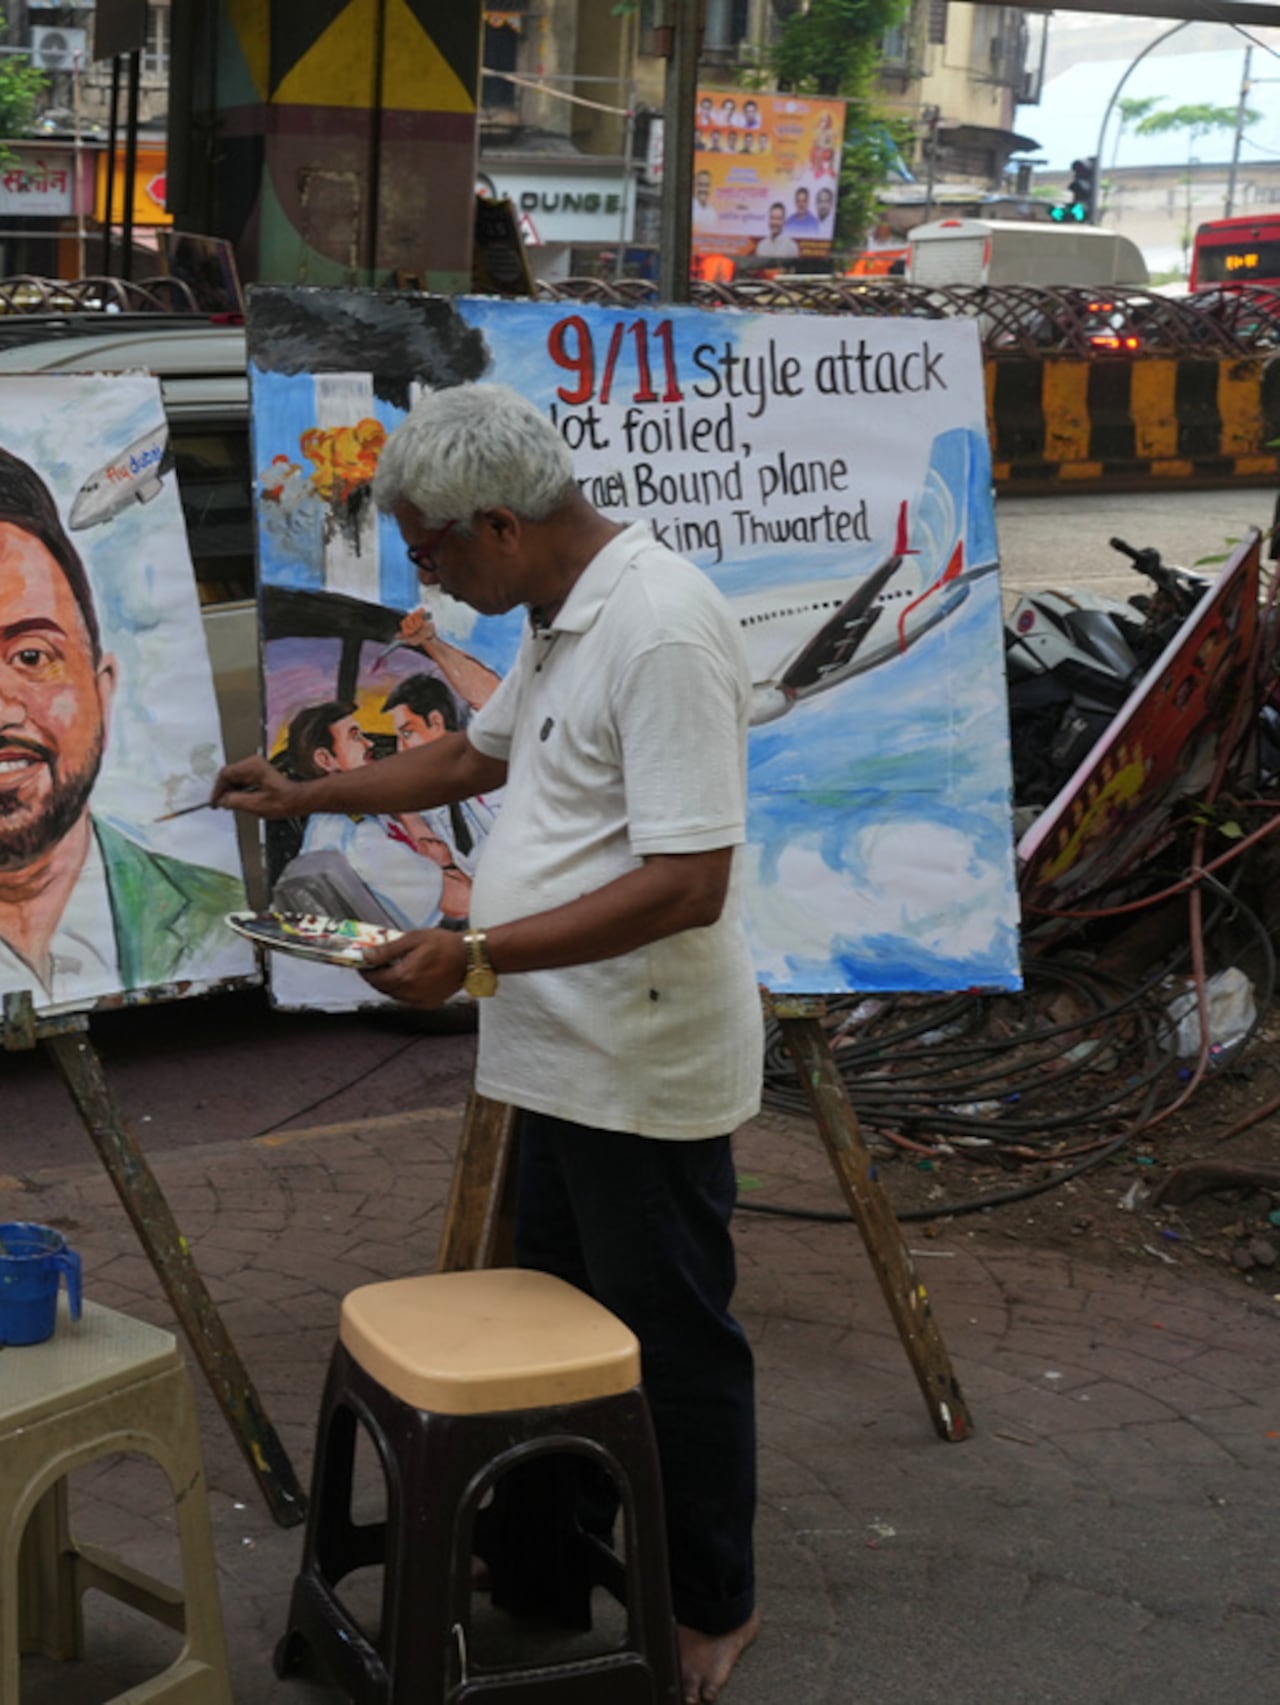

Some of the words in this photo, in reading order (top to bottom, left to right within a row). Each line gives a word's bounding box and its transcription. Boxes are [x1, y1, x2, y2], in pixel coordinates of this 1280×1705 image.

[503, 191, 620, 214] OUNGE
[547, 315, 685, 406] 9/11
[692, 339, 804, 419] Style
[815, 339, 947, 398] attack
[550, 403, 610, 450] lot
[622, 402, 752, 458] foiled,
[634, 462, 743, 506] Bound
[758, 451, 848, 505] plane
[732, 500, 871, 545] Thwarted
